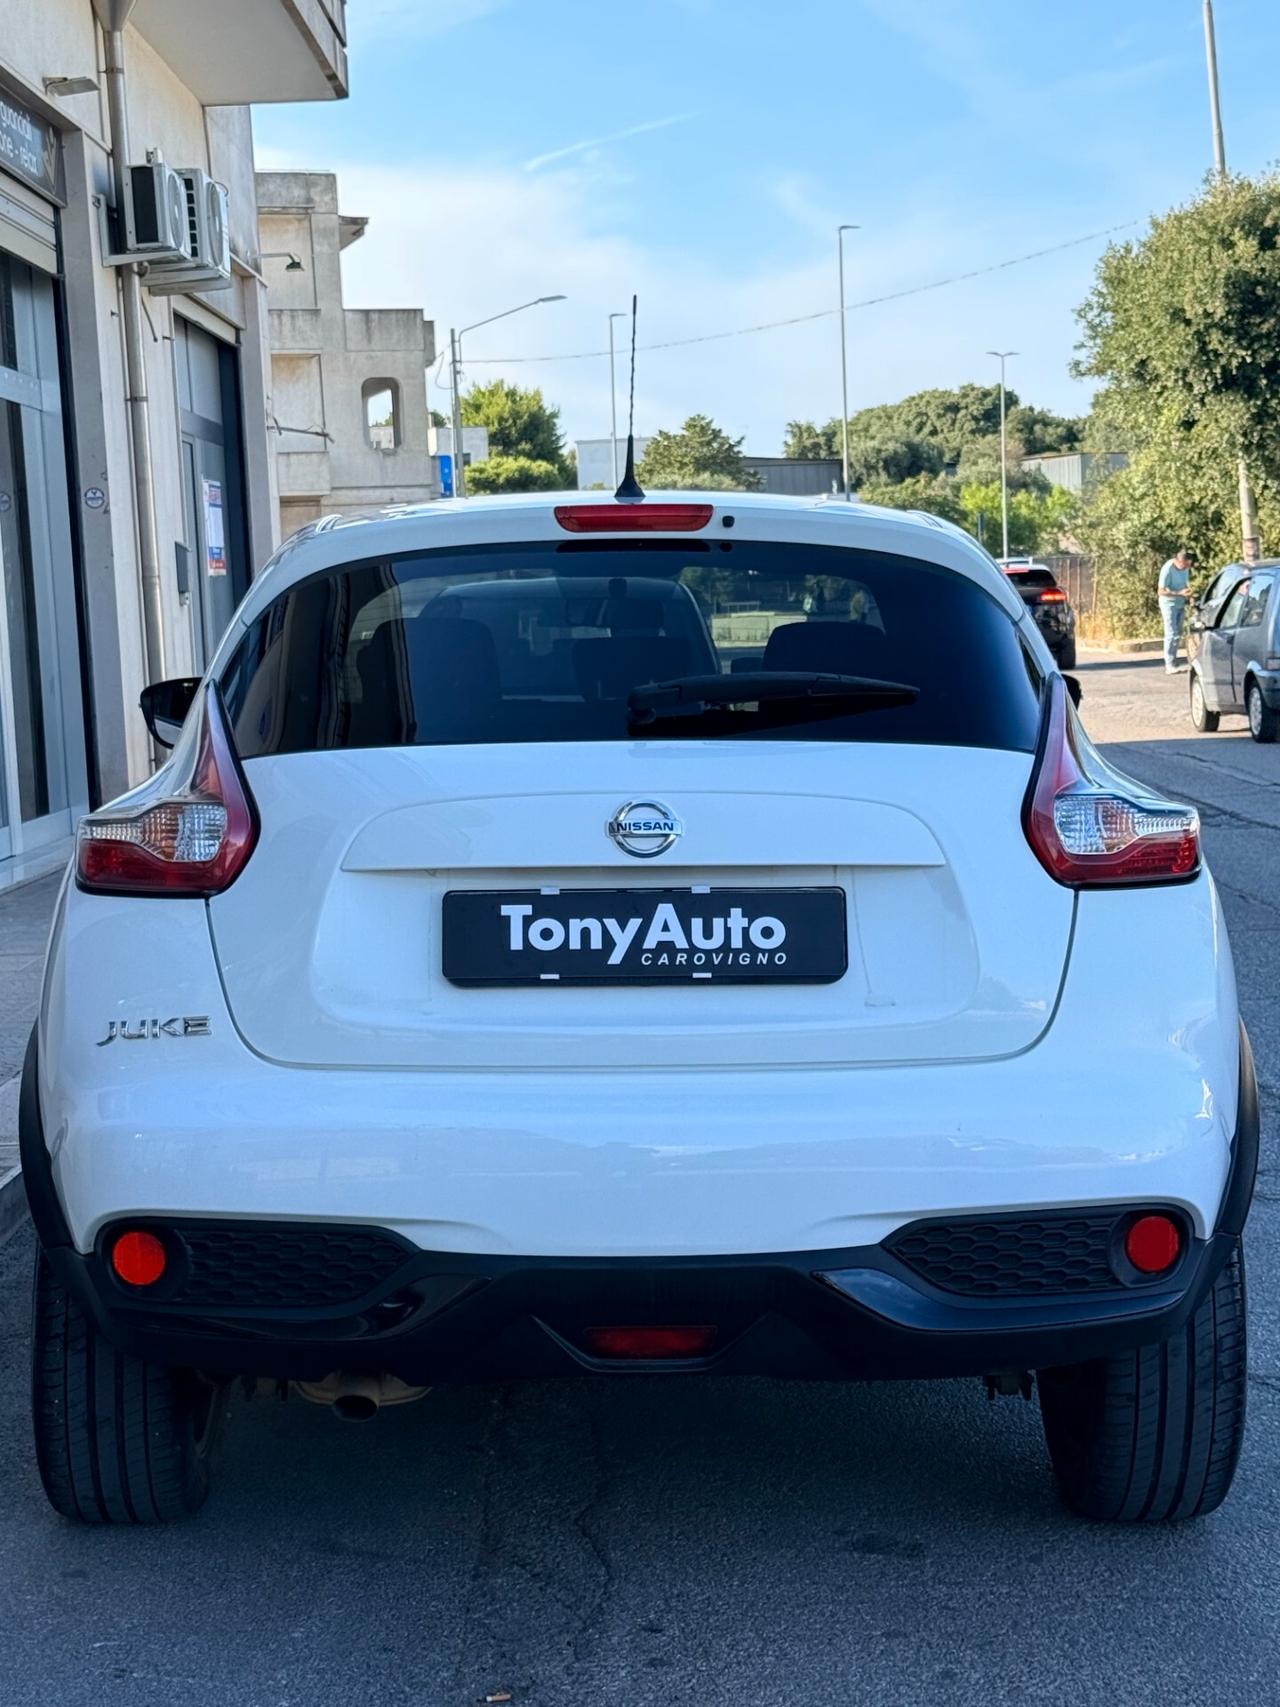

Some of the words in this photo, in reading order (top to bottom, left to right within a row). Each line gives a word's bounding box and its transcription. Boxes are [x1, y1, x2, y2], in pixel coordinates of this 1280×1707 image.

[616, 821, 674, 832] NISSAN
[500, 903, 786, 965] TonyAuto
[641, 952, 788, 966] CAROVIGNO
[96, 1016, 212, 1047] JUKE
